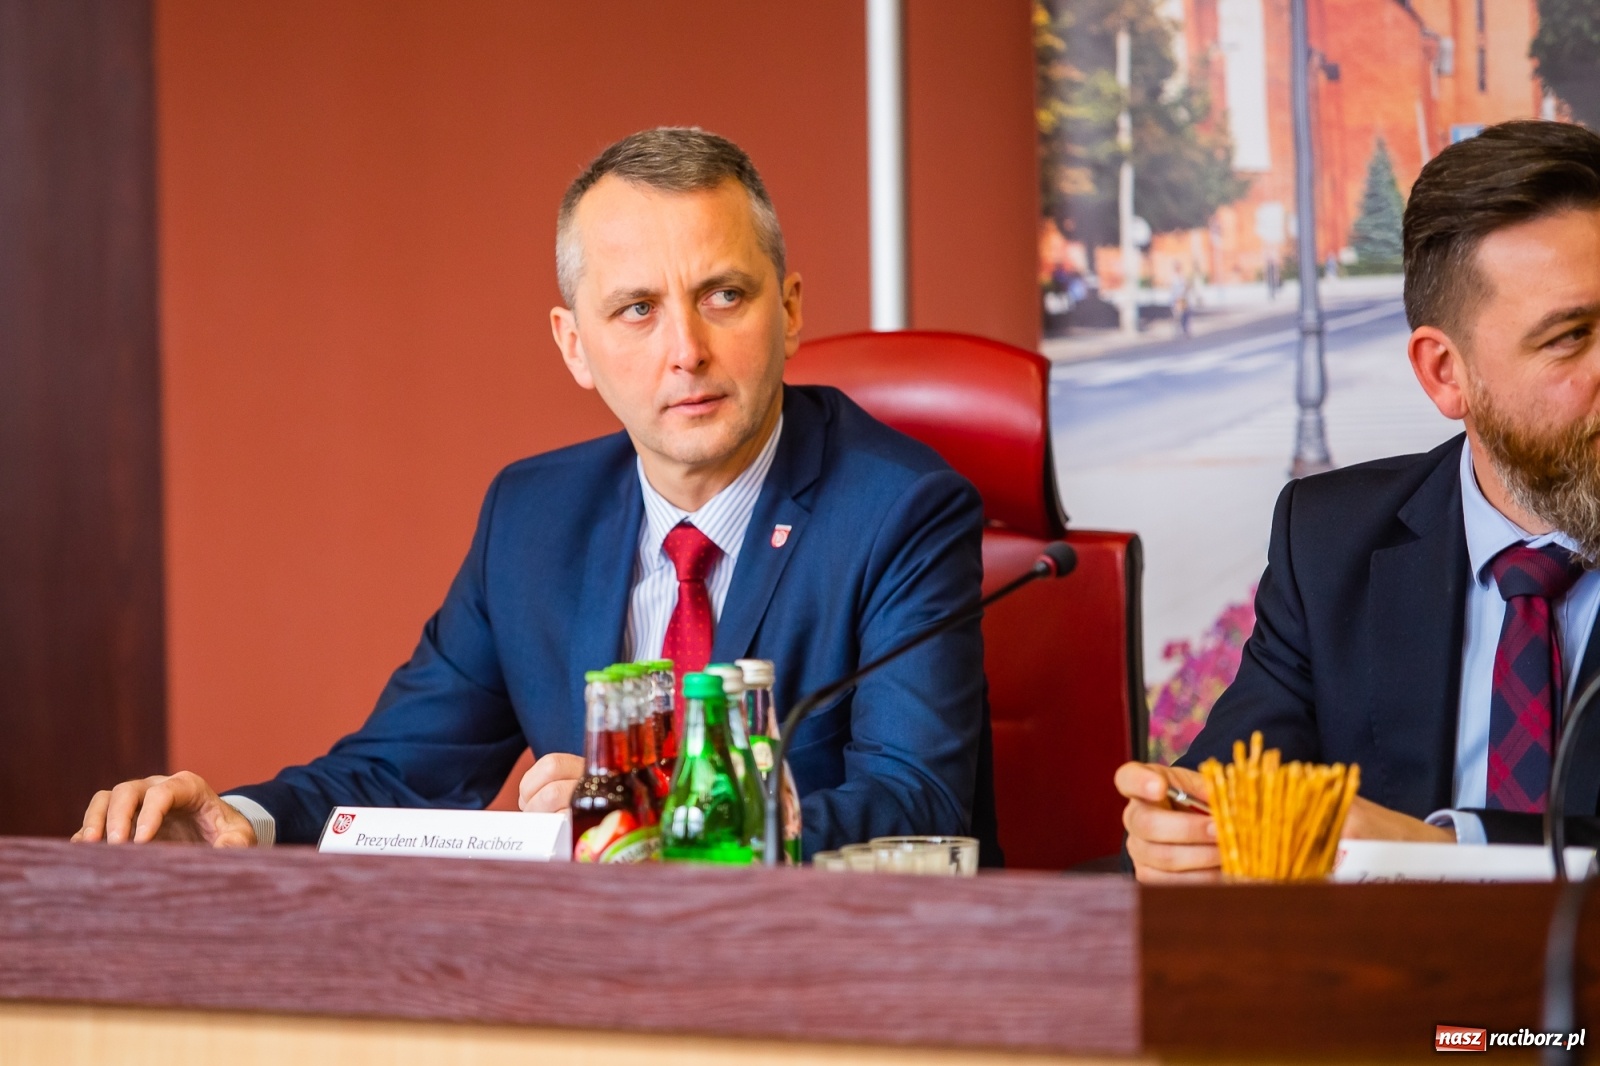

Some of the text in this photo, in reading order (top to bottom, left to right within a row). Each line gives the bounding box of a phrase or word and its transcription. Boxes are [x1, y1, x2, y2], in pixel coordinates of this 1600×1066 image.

[355, 833, 523, 851] Prezydent Miasta Racibórz
